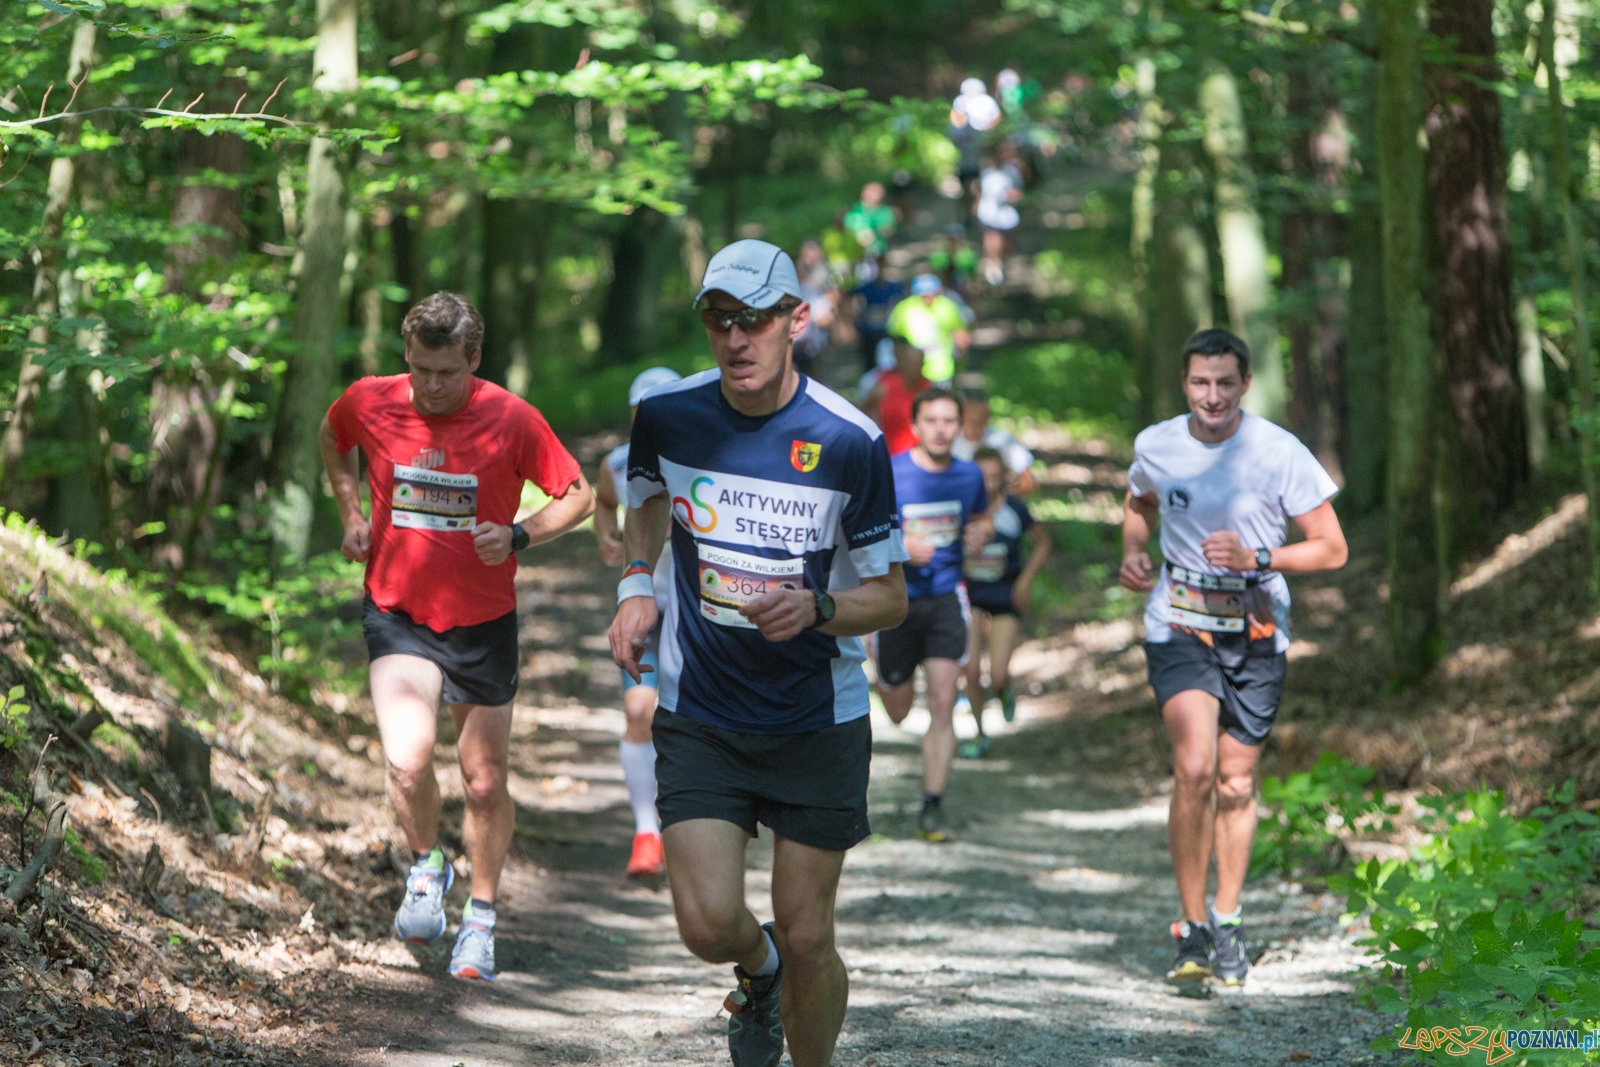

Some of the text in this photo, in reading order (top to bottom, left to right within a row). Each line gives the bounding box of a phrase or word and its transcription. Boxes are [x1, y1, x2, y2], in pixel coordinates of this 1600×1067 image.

[411, 448, 445, 469] RUN
[440, 477, 472, 485] WILKIEM
[420, 485, 451, 505] 194
[718, 489, 818, 519] AKTYWNY
[735, 517, 821, 543] STĘSZEW
[707, 552, 795, 574] POGOŃ ZA WILKIEM
[726, 573, 768, 597] 364
